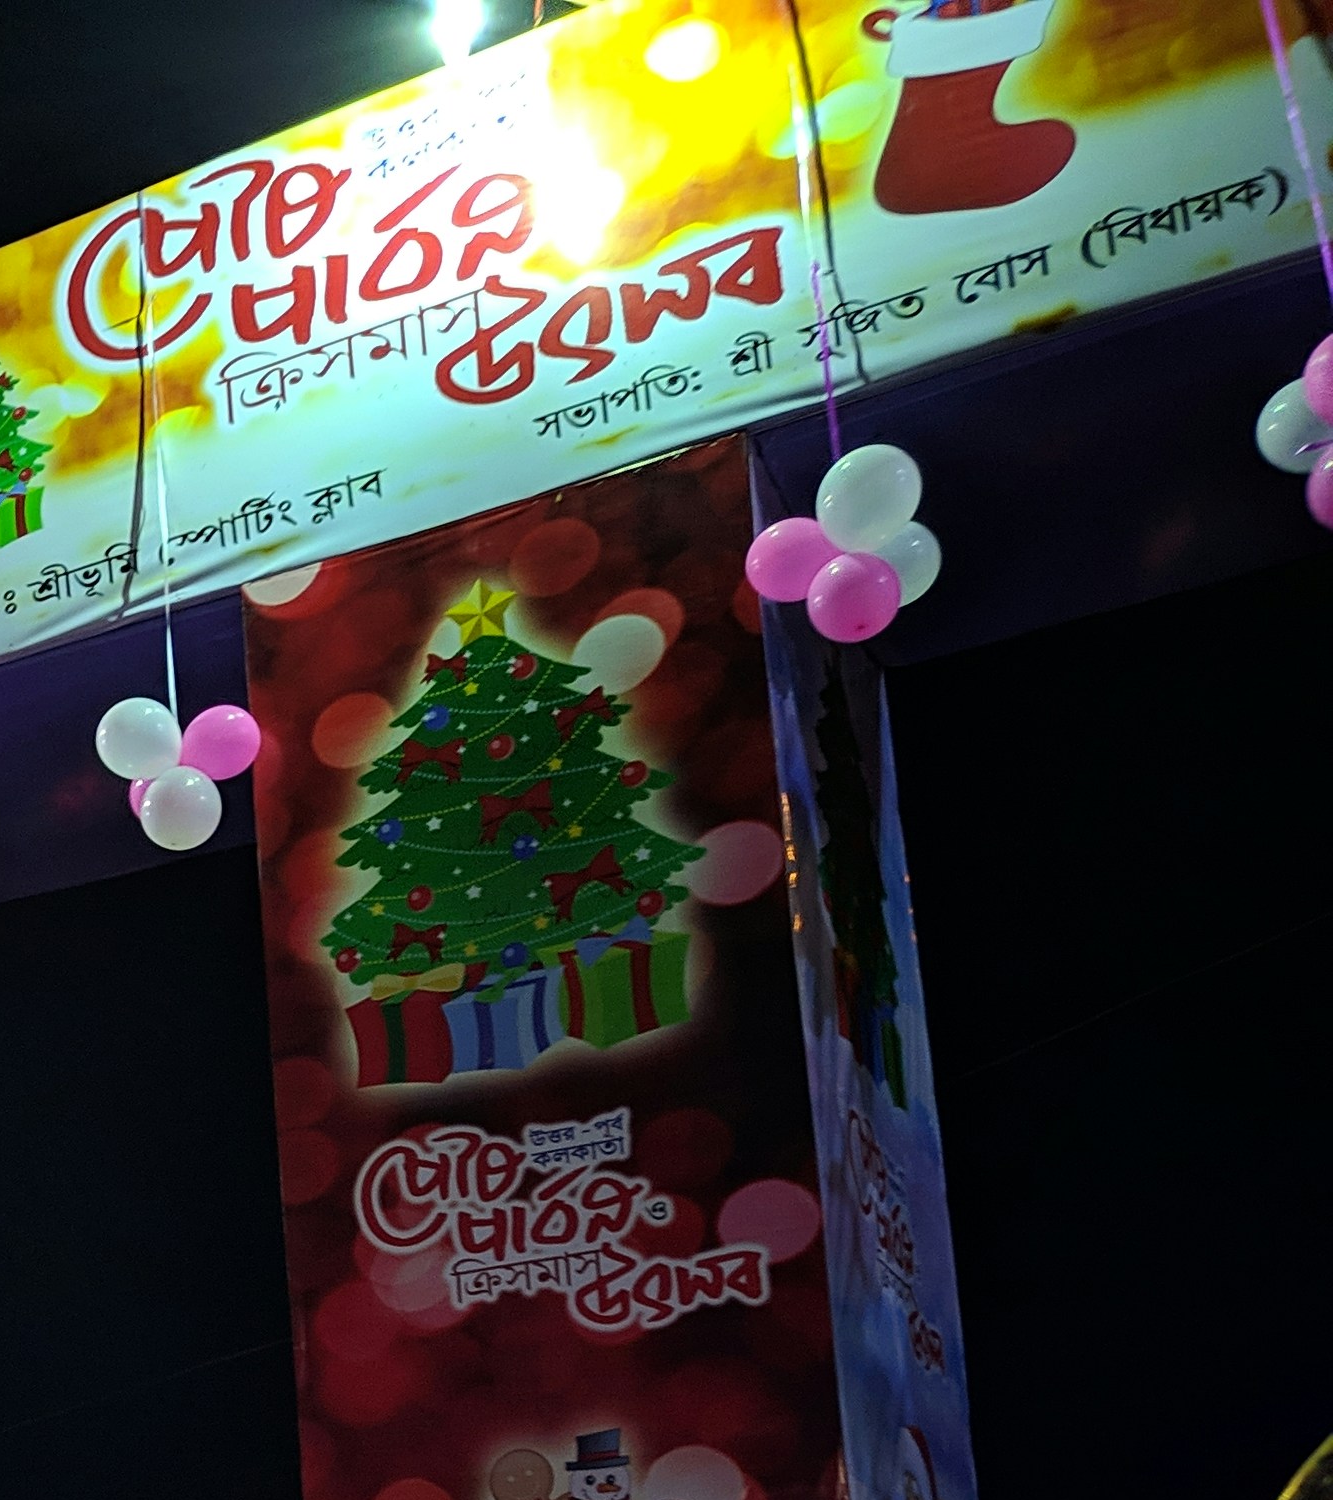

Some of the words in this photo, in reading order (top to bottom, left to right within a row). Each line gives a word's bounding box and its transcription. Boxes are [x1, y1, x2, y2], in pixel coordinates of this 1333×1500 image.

[725, 330, 776, 377] শ্রী
[797, 286, 929, 363] সুজিত
[952, 244, 1053, 304] বোস
[1080, 165, 1290, 269] (বিধায়ক)
[215, 286, 486, 425] ক্রিসমাস
[434, 226, 784, 405] উৎসব
[304, 467, 388, 525] ক্লাব
[531, 1136, 625, 1166] কলকাতা
[450, 1249, 604, 1303] ক্রিসমাস
[575, 1243, 763, 1324] উৎসব
